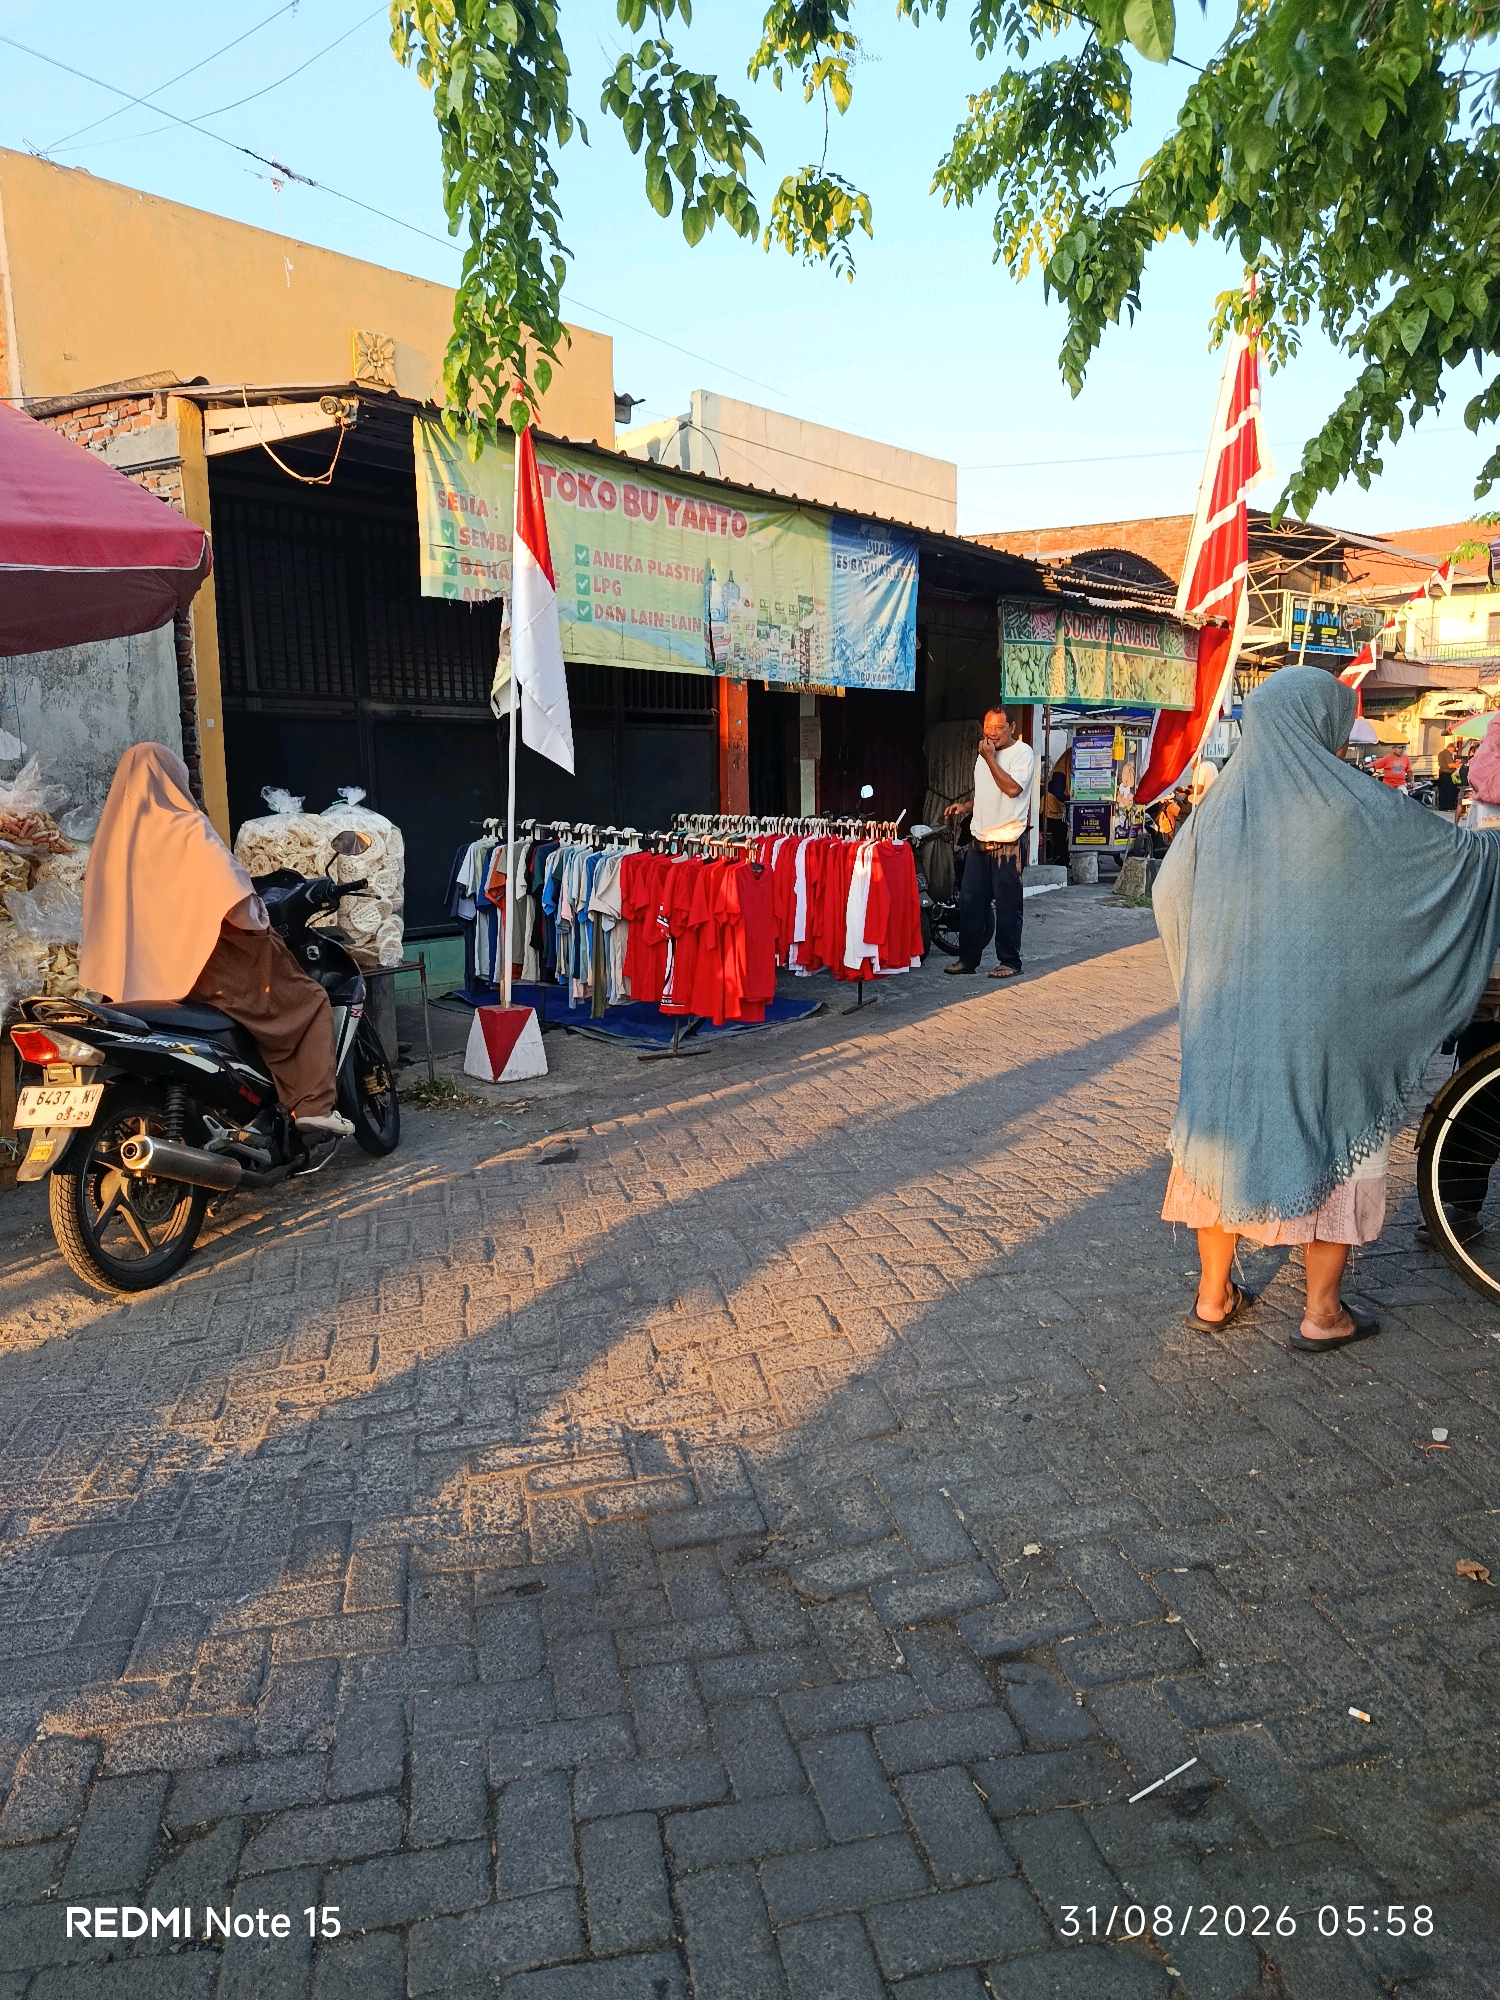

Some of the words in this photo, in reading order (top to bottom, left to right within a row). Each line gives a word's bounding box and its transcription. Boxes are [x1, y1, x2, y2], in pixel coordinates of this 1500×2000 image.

[437, 489, 489, 518] SEDIA
[538, 463, 617, 511] TOKO
[622, 484, 659, 522] BU
[664, 495, 748, 539] YANTO
[458, 526, 513, 553] SEMB
[866, 539, 891, 557] JUAL
[459, 556, 513, 582] BAHA
[593, 550, 644, 574] ANEKA
[647, 559, 705, 585] PLASTIK
[836, 554, 848, 570] ES
[593, 574, 623, 597] LPG
[594, 603, 626, 622] DAN
[630, 608, 702, 633] LAIN-LAIN
[1062, 609, 1111, 643] SURGA
[1114, 618, 1160, 650] SNACK
[49, 1067, 72, 1075] HONDA
[36, 1090, 71, 1106] 6437
